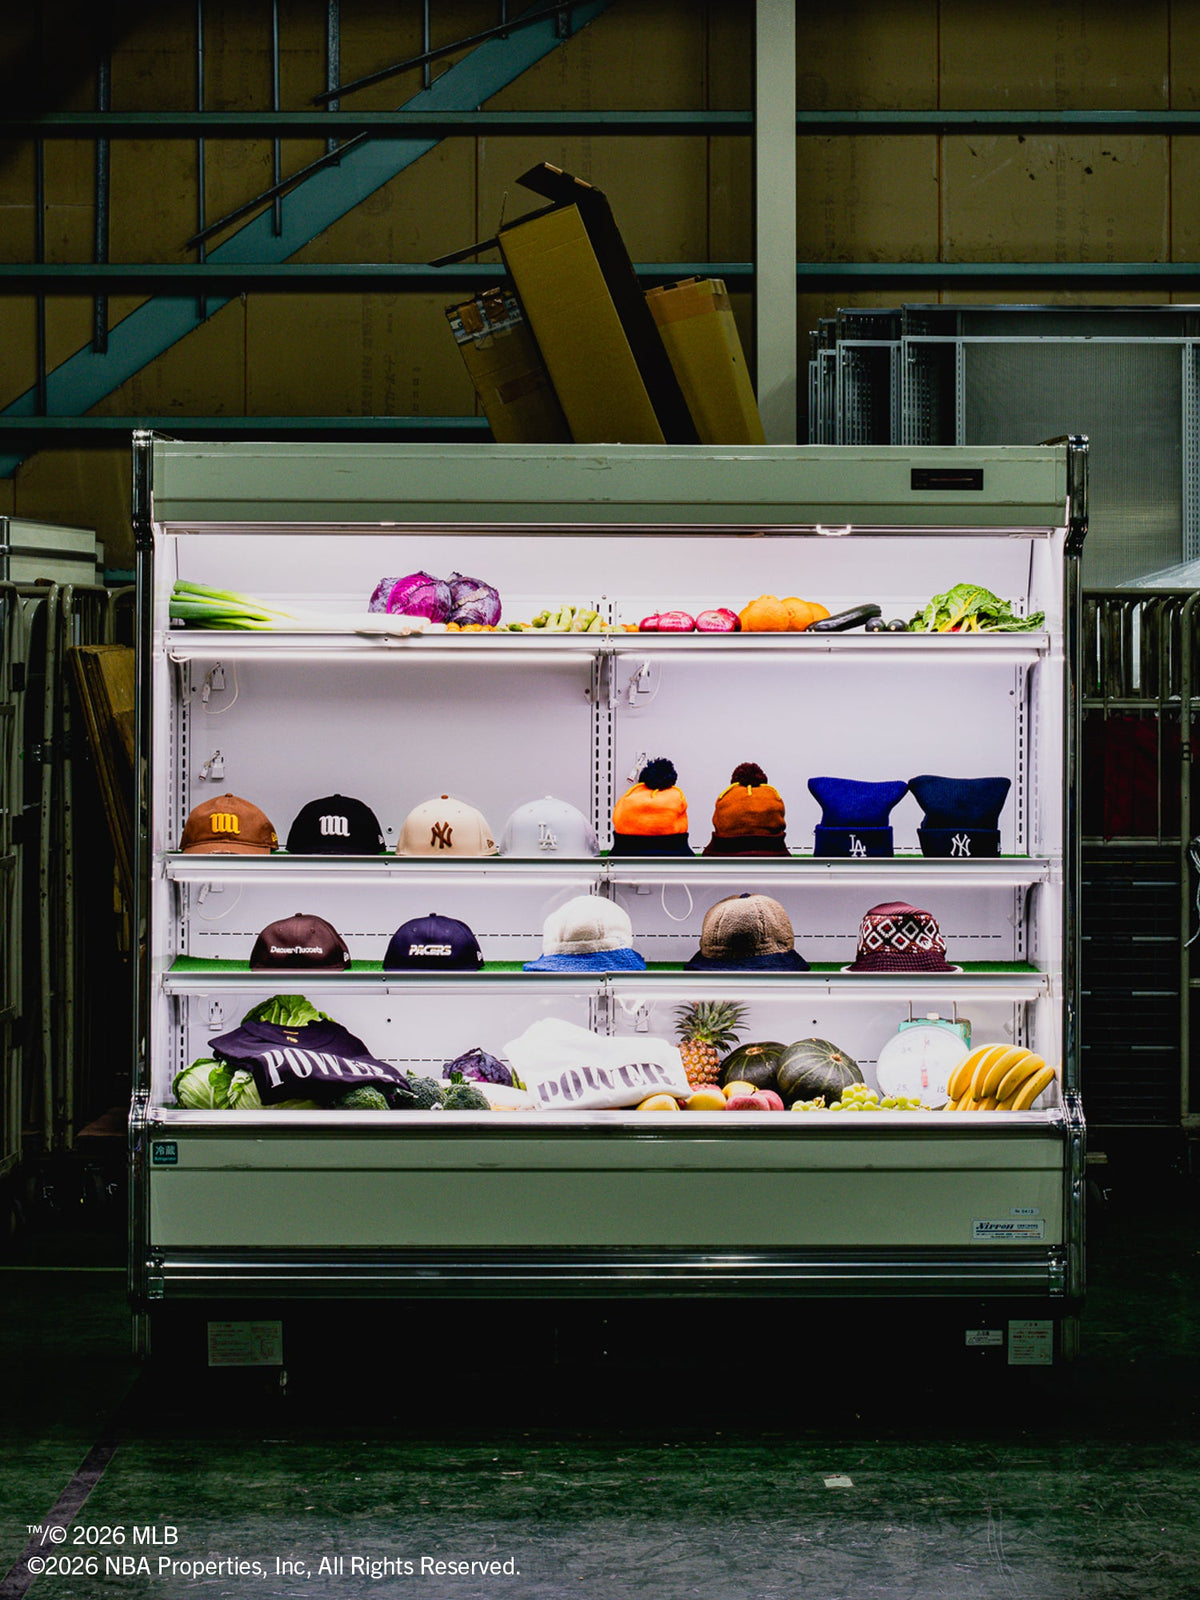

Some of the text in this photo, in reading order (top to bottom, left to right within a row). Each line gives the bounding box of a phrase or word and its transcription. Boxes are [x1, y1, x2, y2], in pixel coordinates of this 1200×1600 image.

[430, 821, 453, 849] NY
[538, 821, 558, 851] LA
[849, 834, 867, 857] LA
[950, 833, 971, 857] NY
[409, 944, 452, 956] PACERS
[260, 1047, 401, 1088] POWER
[537, 1063, 676, 1102] POWER
